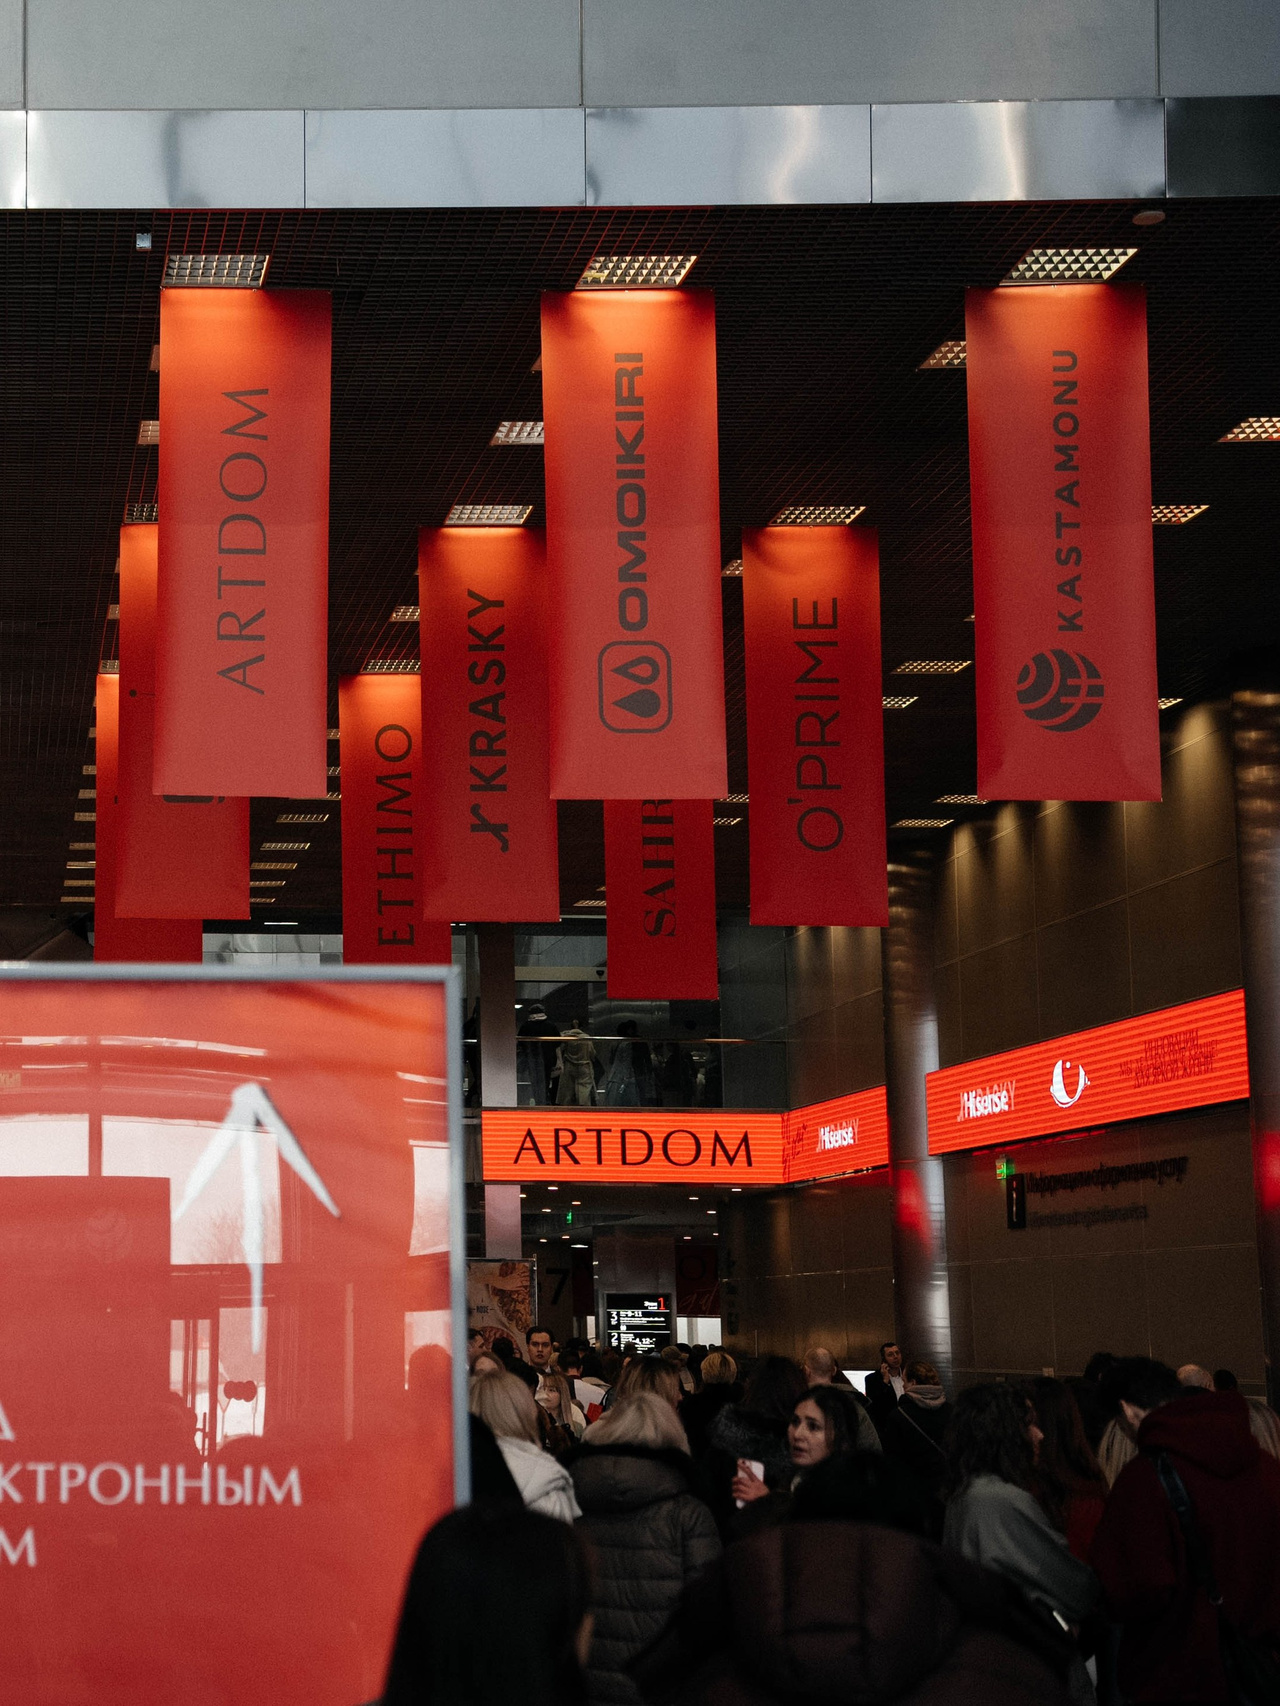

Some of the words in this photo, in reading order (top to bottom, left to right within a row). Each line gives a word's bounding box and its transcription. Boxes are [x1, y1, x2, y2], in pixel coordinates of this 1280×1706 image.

[216, 388, 269, 695] ARTDOM
[614, 353, 648, 631] OMOIKIRI
[1053, 350, 1084, 633] KASTAMONU
[467, 588, 508, 792] KRASKY
[788, 596, 844, 852] O'PRIME
[374, 723, 415, 947] ETHIMO
[513, 1127, 753, 1167] ARTDOM
[963, 1089, 1009, 1118] Hisense
[546, 1268, 569, 1304] 7
[610, 1311, 618, 1321] 3
[611, 1333, 618, 1342] 2
[658, 1297, 666, 1310] 1
